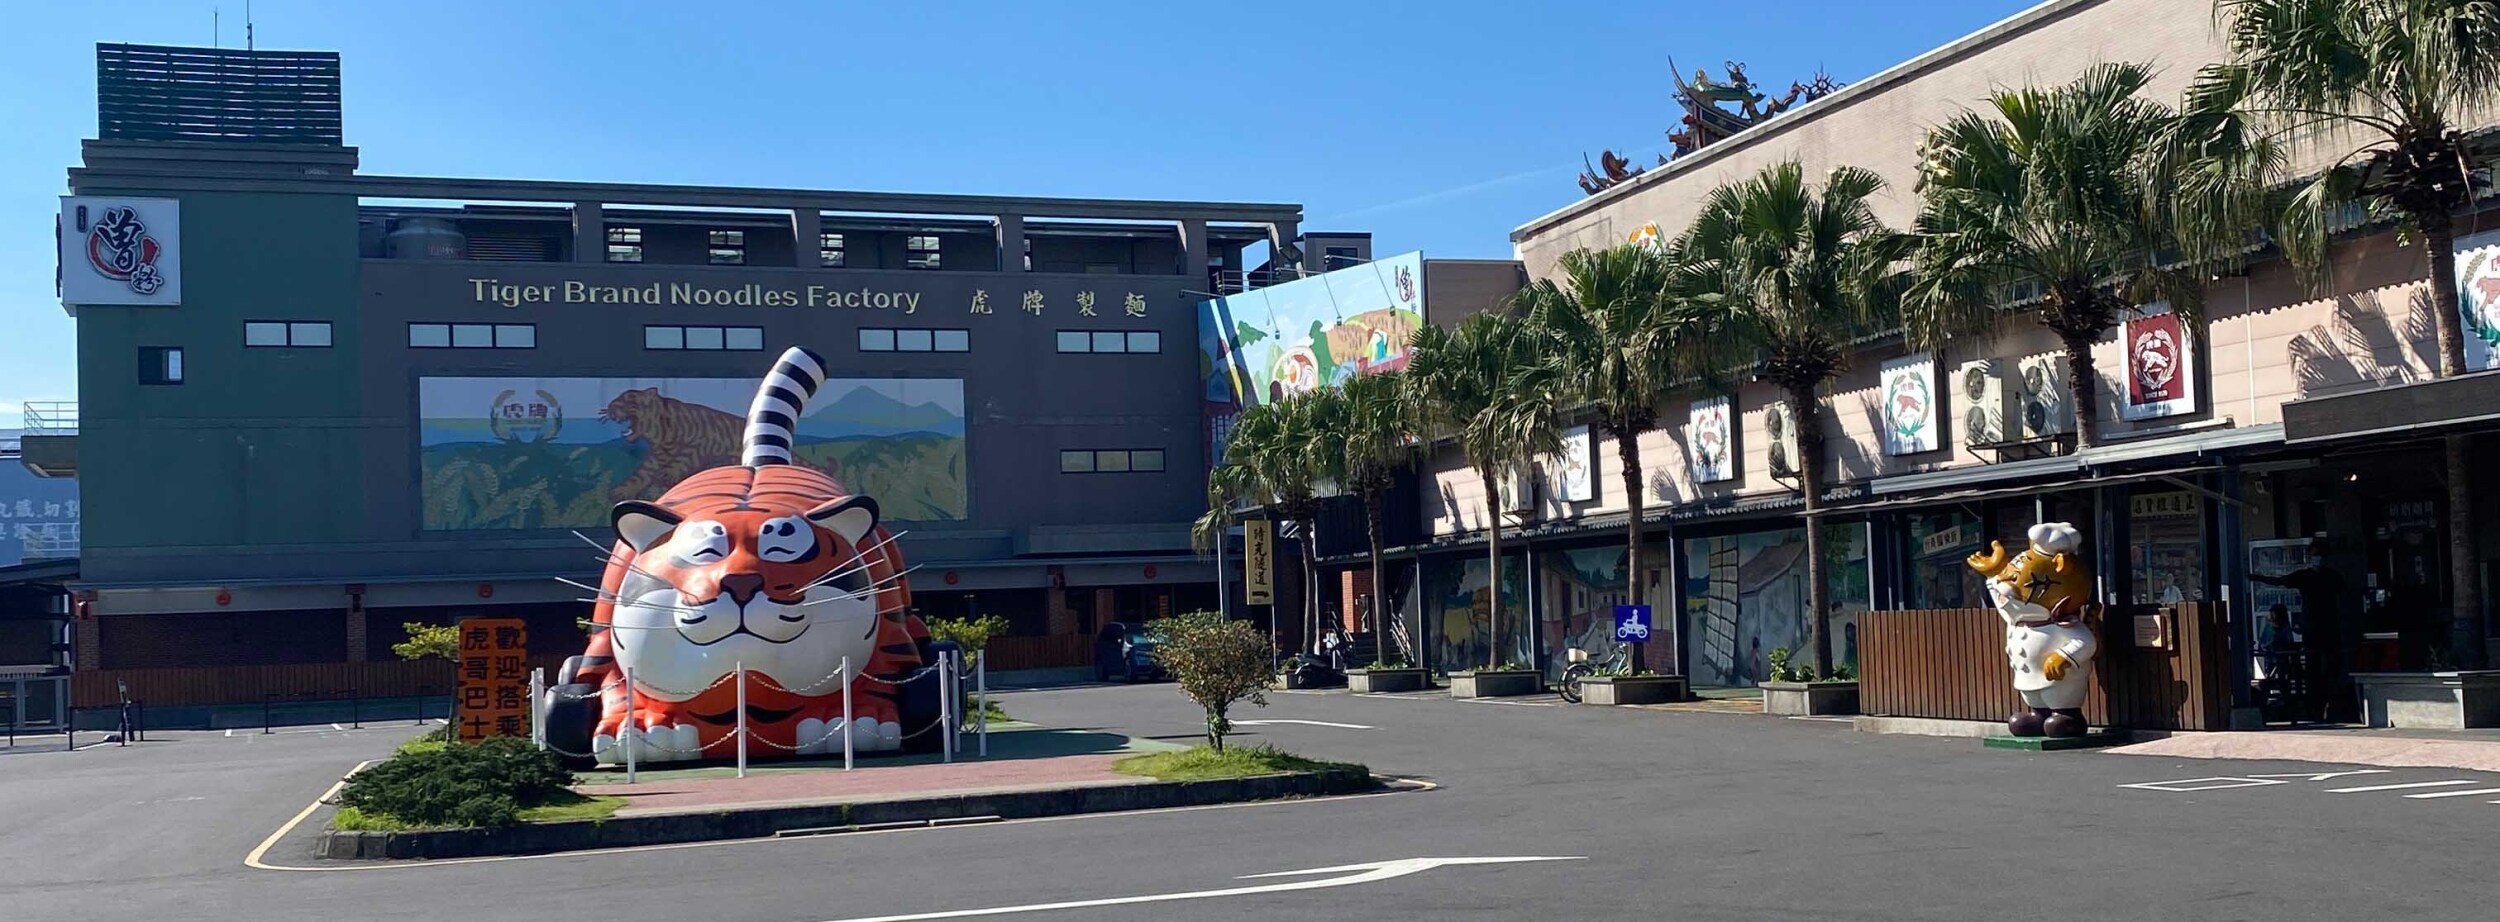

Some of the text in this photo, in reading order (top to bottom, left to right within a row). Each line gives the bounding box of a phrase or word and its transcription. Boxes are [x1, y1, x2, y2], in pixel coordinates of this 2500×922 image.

[468, 278, 920, 314] Tiger Brand Noodles Factory
[970, 289, 1147, 318] 虎牌製麵
[503, 402, 548, 418] 虎牌
[463, 626, 491, 739] 虎哥巴士
[495, 625, 522, 737] 歡迎搭乘
